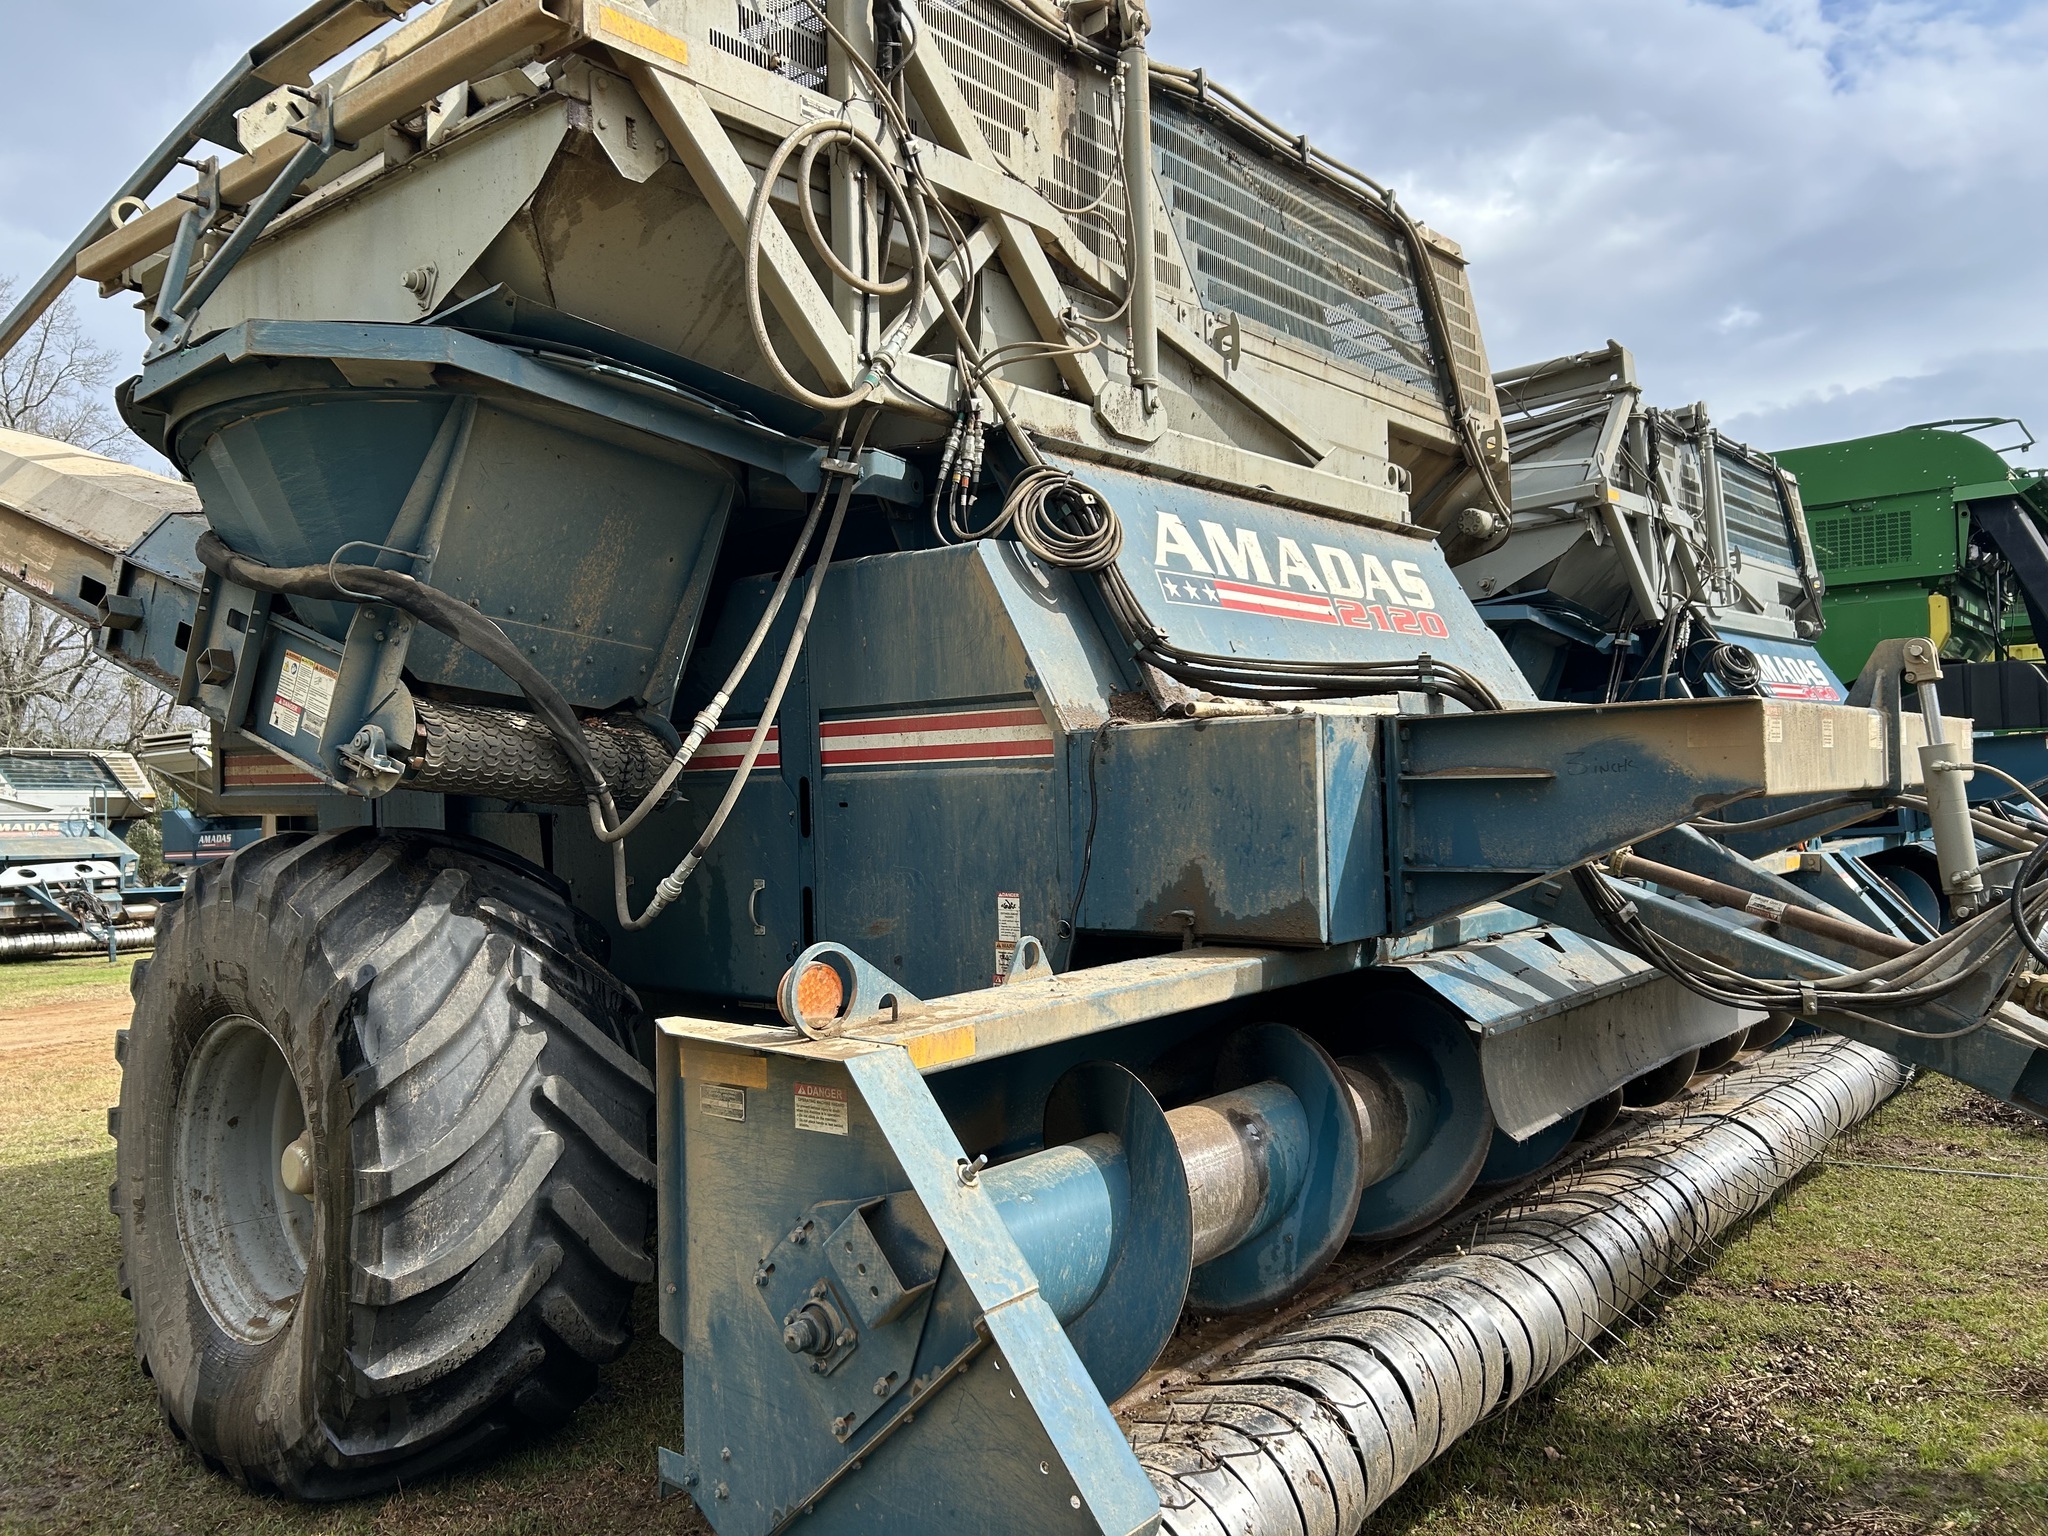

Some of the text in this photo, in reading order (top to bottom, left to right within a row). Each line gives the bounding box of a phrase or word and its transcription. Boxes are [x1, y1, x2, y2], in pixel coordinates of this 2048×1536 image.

[1154, 510, 1435, 610] AMADAS
[1334, 598, 1450, 639] 2120
[1754, 653, 1829, 686] MADAS
[1565, 752, 1588, 776] 3
[198, 834, 232, 844] AMADAS
[807, 1086, 843, 1100] DANGER
